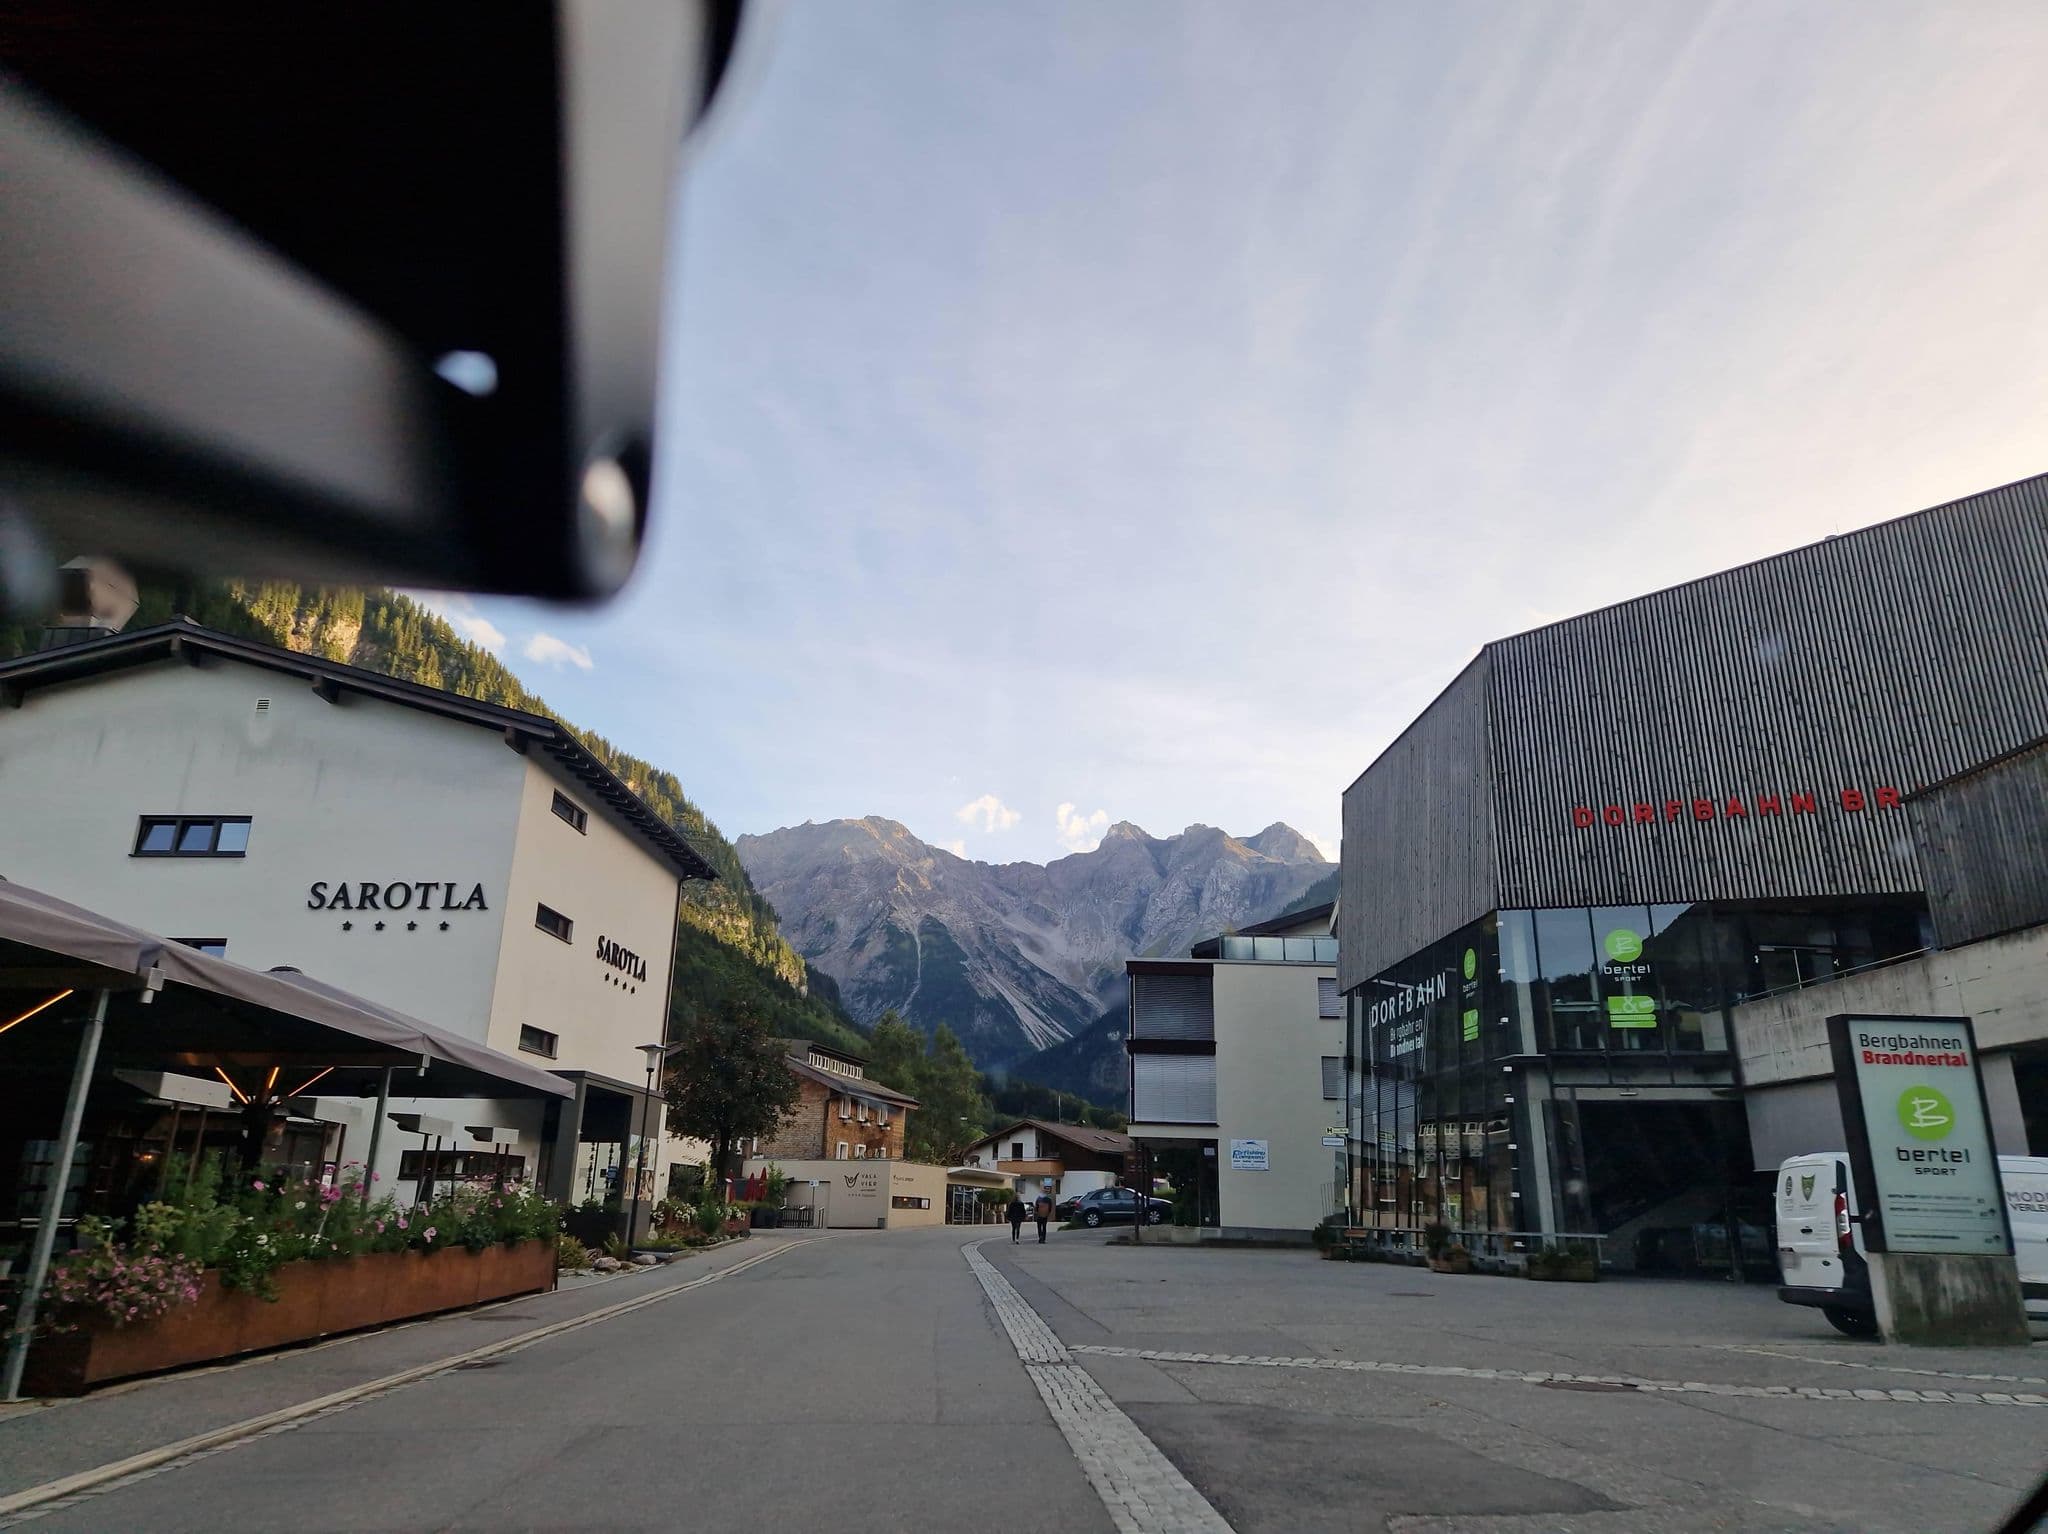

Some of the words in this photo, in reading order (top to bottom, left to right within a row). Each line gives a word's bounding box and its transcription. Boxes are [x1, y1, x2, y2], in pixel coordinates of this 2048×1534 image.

[1573, 791, 1817, 829] DORFBAHN
[1841, 784, 1922, 812] BR
[307, 880, 489, 911] SAROTLA
[596, 934, 647, 982] SAROTLA
[1603, 964, 1651, 975] bertel
[1370, 971, 1446, 1028] DORFBAHN
[1858, 1033, 1962, 1053] Bergbahnen
[1862, 1051, 1969, 1068] Brandnertal
[1896, 1146, 1971, 1164] bertel
[1914, 1166, 1958, 1177] SPORT
